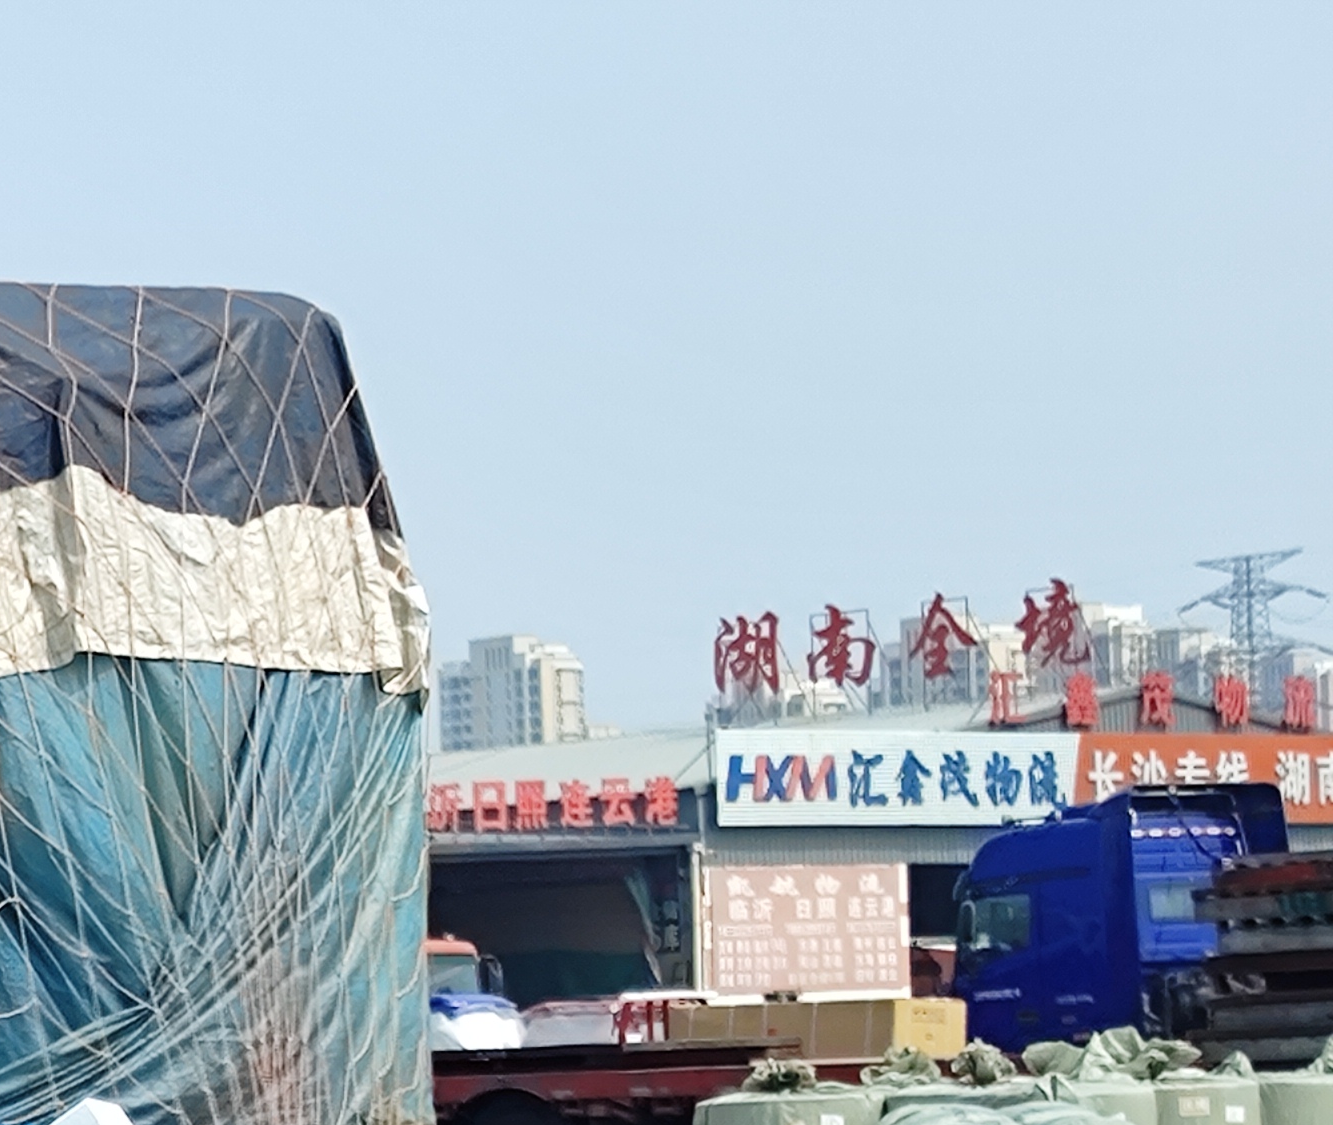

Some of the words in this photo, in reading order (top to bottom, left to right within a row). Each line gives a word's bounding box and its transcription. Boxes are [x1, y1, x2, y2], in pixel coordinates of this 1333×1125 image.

[714, 577, 1092, 695] 湖南全境
[725, 755, 838, 803] HXM
